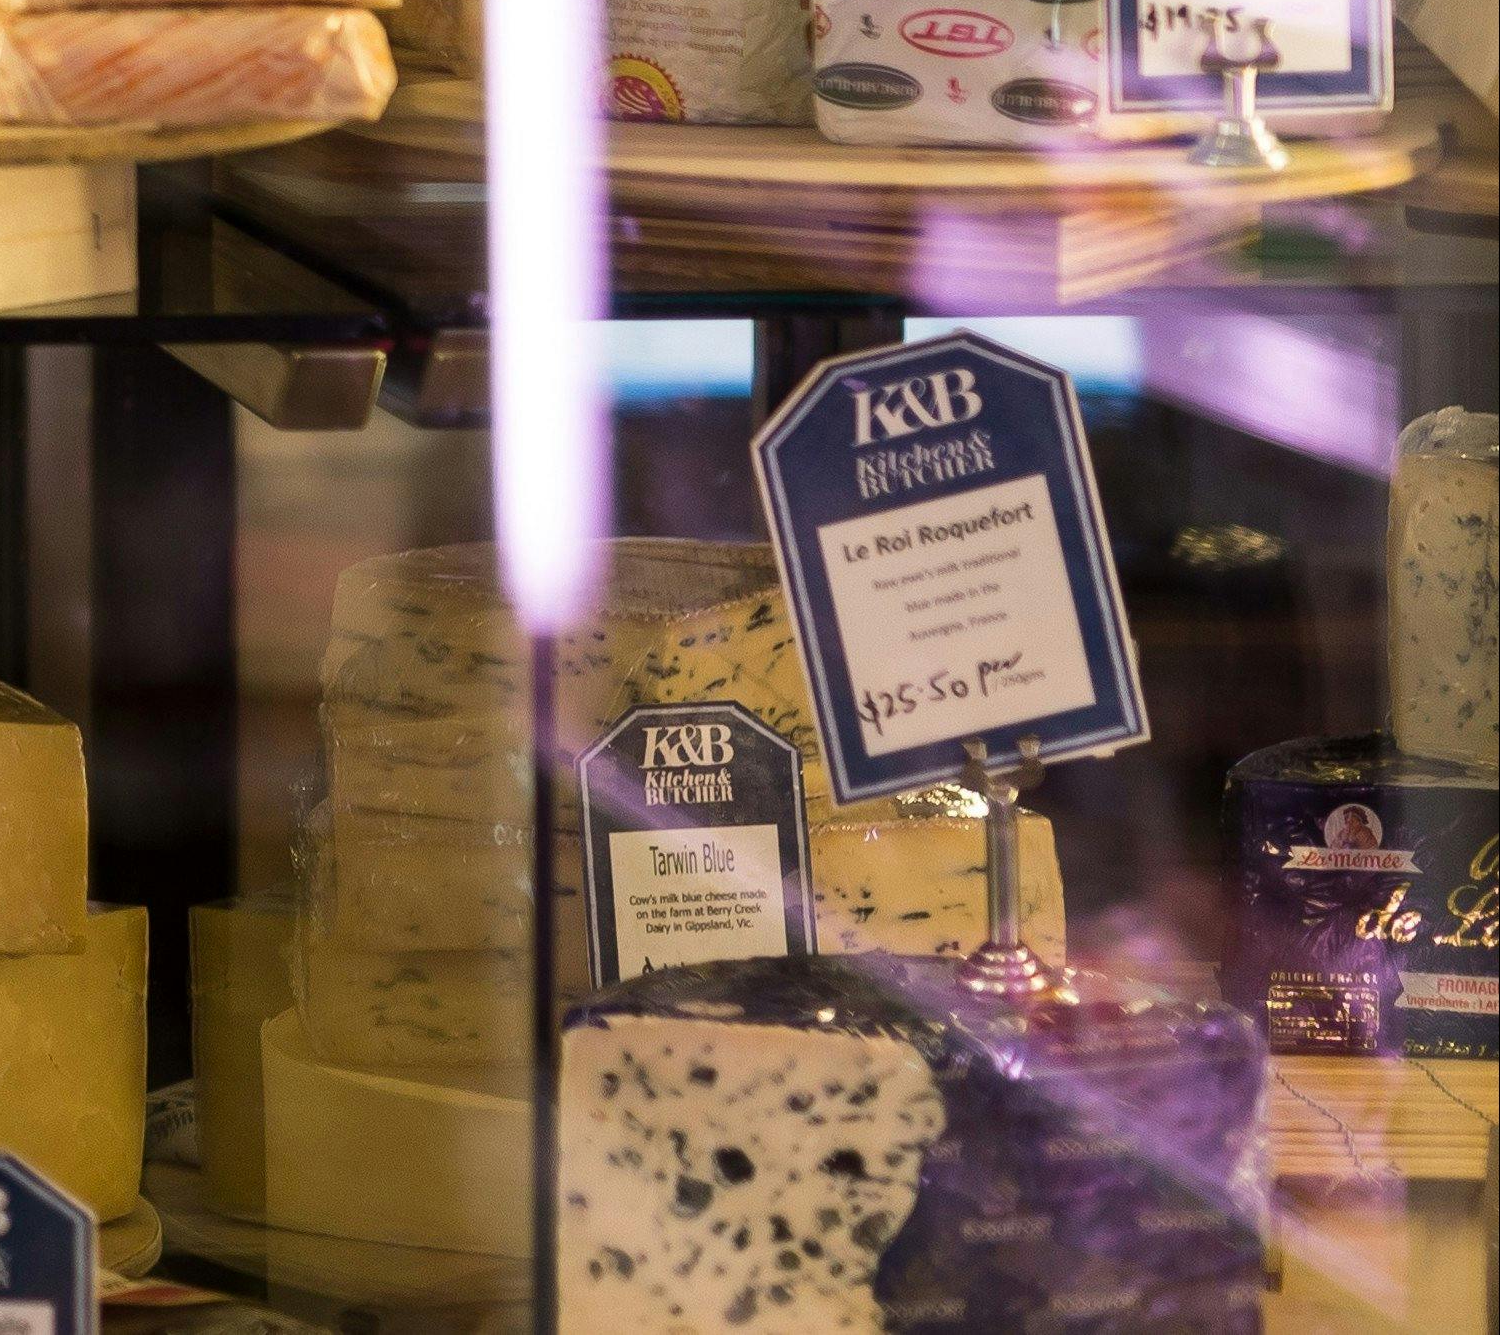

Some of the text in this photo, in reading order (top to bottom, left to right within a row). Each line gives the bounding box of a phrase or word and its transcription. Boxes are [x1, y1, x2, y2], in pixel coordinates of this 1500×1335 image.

[854, 367, 984, 448] K&B
[842, 501, 1034, 564] Le Roi Roquefort
[638, 723, 735, 770] K&B
[645, 768, 731, 788] Kitchen&
[645, 783, 734, 806] BUTCHER
[649, 841, 735, 877] Tarwin Blue
[629, 889, 767, 907] Cow's milk blue cheese made
[636, 902, 761, 920] on the farm at Berry Creek
[1355, 882, 1422, 942] de
